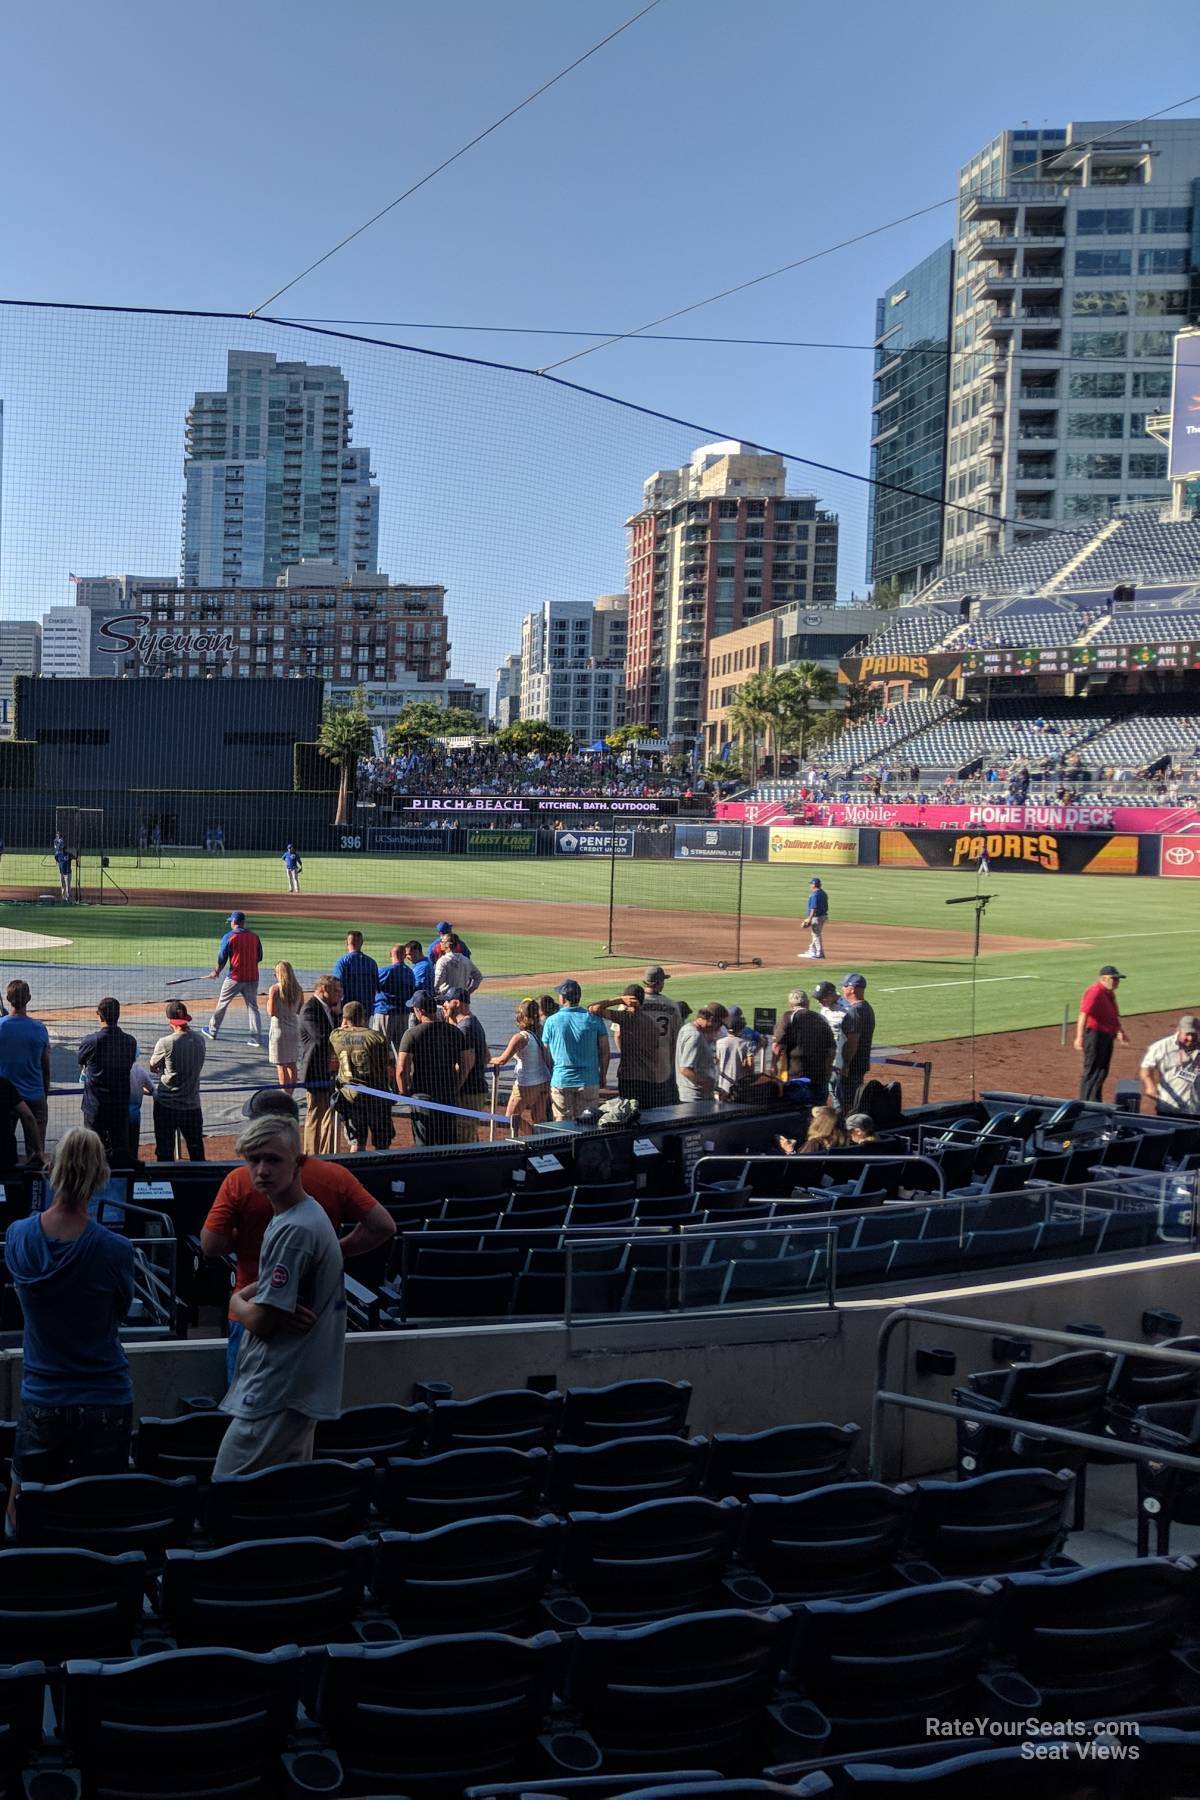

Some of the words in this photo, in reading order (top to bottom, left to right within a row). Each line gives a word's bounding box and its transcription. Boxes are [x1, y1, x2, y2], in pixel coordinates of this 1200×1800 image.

[97, 613, 240, 665] Sycuan
[1158, 646, 1176, 654] ARI
[1182, 645, 1189, 654] 0
[1119, 660, 1127, 668] 4
[1157, 658, 1177, 666] ATL
[858, 655, 929, 680] PADRES
[412, 799, 464, 809] PIRCH
[476, 800, 523, 809] BEACH
[538, 801, 582, 810] KITCHEN.
[583, 802, 610, 810] BATH.
[611, 802, 660, 811] OUTDOOR.
[969, 807, 1022, 823] HOME
[1025, 808, 1063, 824] RUN
[1065, 809, 1114, 825] DECK
[340, 836, 361, 849] 396
[469, 835, 501, 845] WEST
[502, 835, 532, 845] LAKE
[579, 836, 628, 846] PENFED
[814, 840, 833, 849] Solar
[834, 841, 857, 850] Power
[690, 848, 728, 856] STREAMING
[952, 834, 1060, 871] PADRES
[656, 1016, 669, 1037] 3
